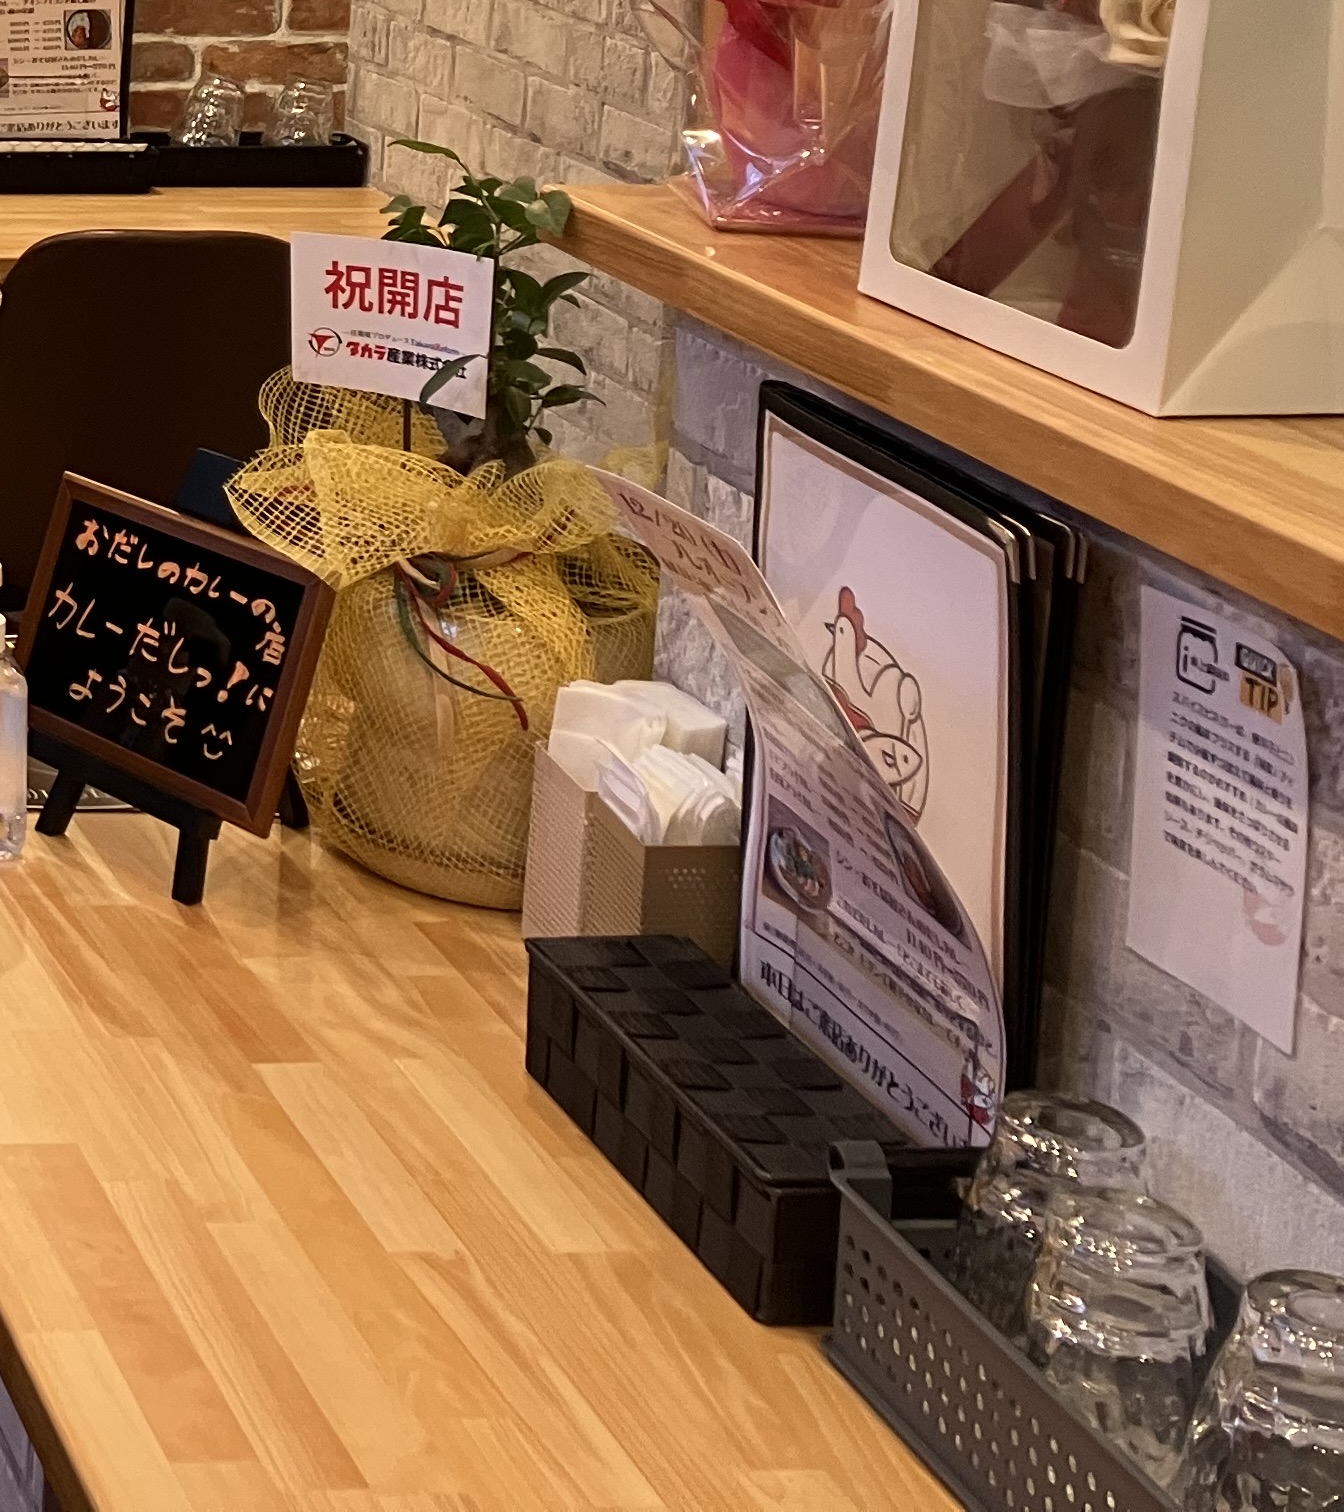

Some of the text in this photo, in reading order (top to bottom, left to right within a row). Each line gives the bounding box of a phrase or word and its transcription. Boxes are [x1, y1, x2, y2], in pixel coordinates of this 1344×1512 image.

[324, 260, 465, 329] 祝開店
[345, 341, 467, 379] タカラ産業株式
[69, 668, 187, 745] ようこそ
[1244, 676, 1279, 717] TIP
